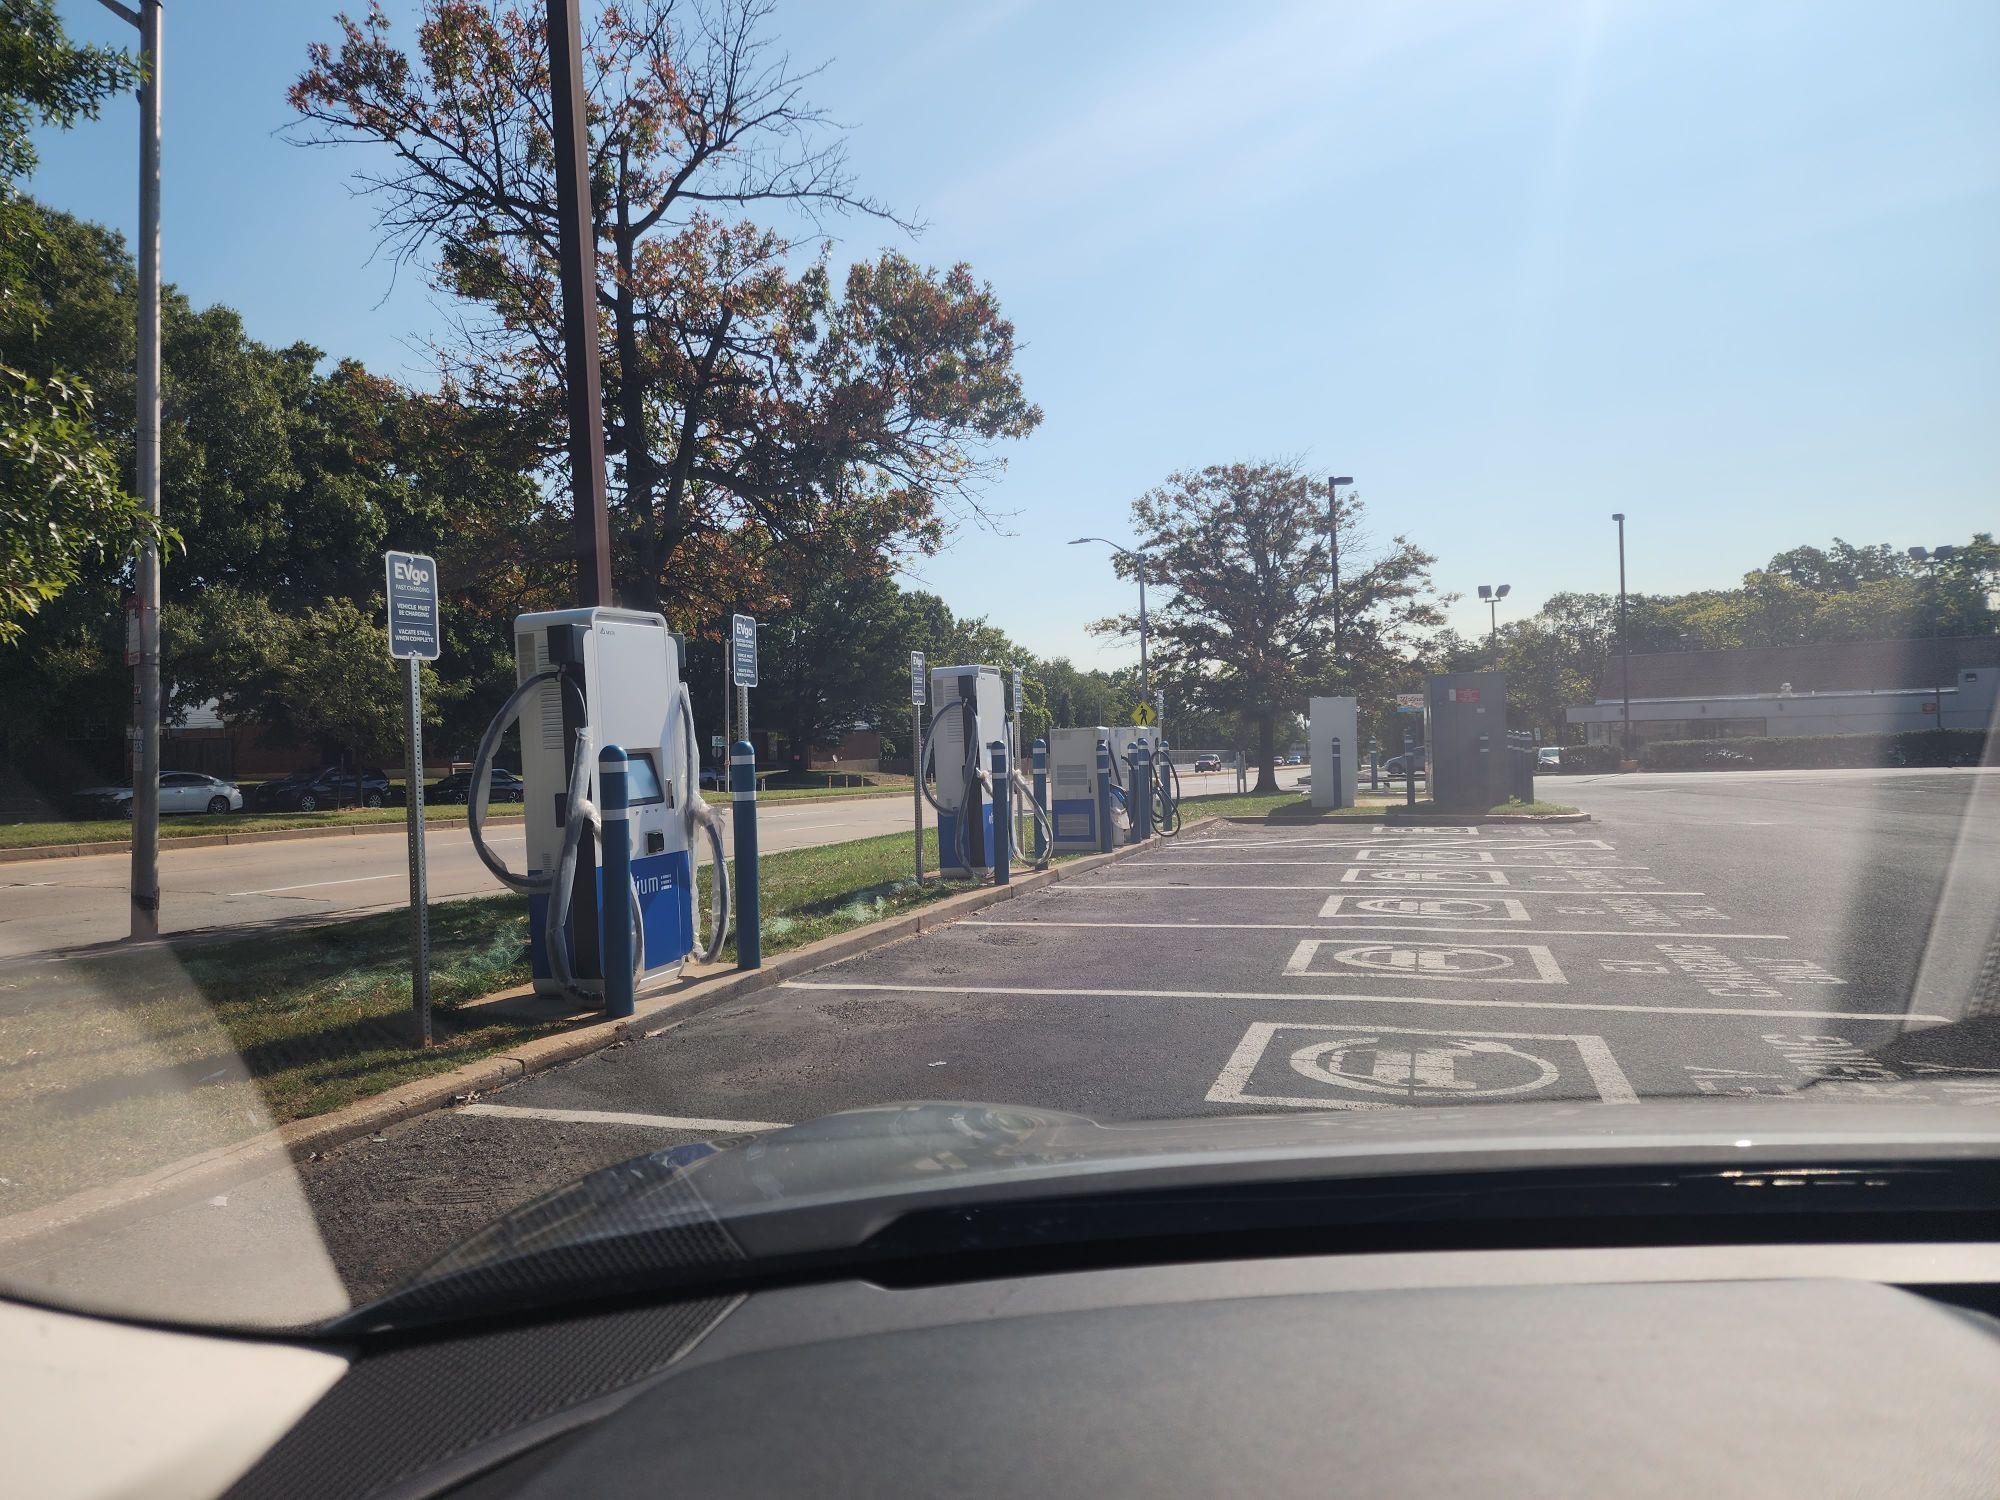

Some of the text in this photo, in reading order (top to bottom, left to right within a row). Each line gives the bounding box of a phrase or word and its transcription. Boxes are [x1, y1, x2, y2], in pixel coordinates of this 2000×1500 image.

[394, 562, 428, 586] EVgo
[398, 628, 416, 636] VACATE
[736, 622, 753, 638] EVgo
